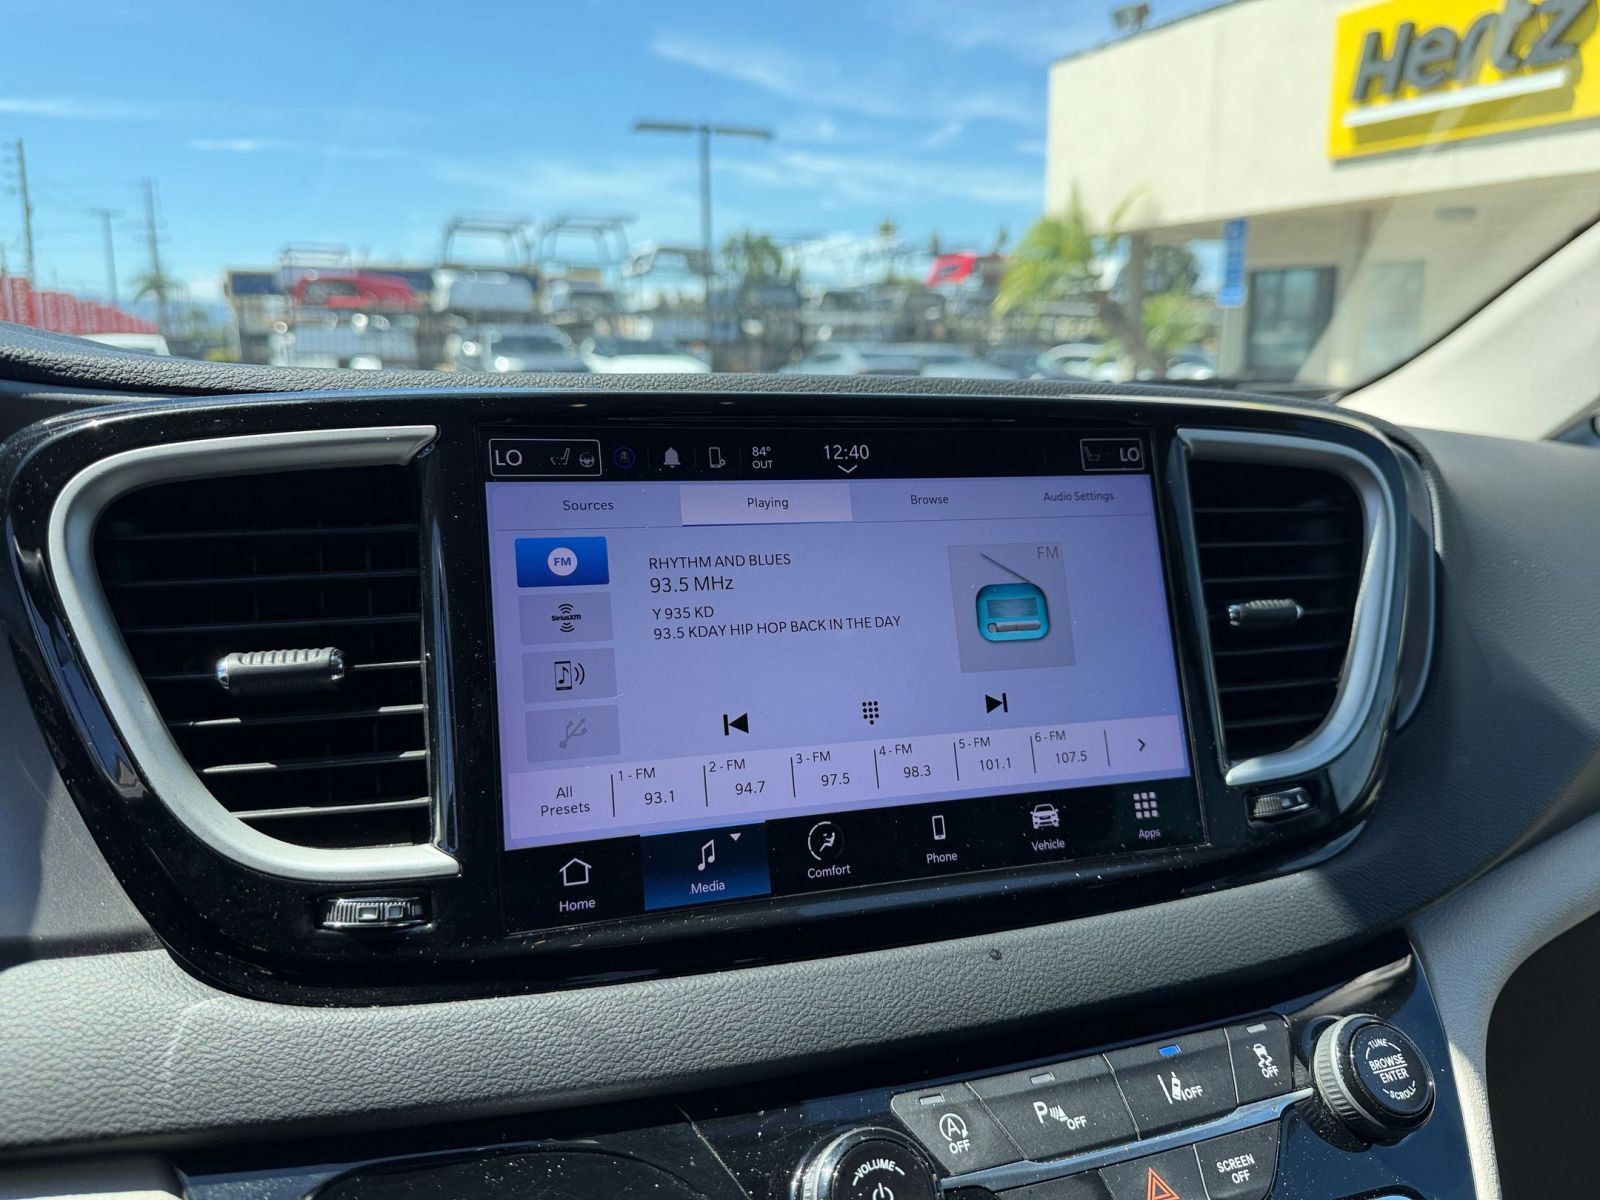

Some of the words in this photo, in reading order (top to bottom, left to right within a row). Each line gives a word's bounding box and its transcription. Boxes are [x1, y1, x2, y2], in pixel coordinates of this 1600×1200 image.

[1352, 0, 1589, 103] Hertz
[495, 449, 523, 466] LO
[752, 447, 771, 457] 84°
[823, 445, 870, 461] 12:40
[1120, 448, 1139, 462] LO
[752, 459, 773, 470] OUT
[747, 497, 789, 510] Playing
[911, 494, 949, 505] Browse
[1044, 491, 1072, 502] Audio
[1074, 491, 1114, 502] Settings
[562, 499, 614, 512] Sources
[1037, 546, 1059, 559] FM
[554, 556, 571, 566] FM
[649, 556, 712, 570] RHYTHM
[715, 555, 745, 567] AND
[749, 554, 791, 566] BLUES
[650, 577, 690, 593] 93.5
[694, 576, 734, 591] MHz
[652, 609, 662, 620] Y
[664, 607, 691, 620] 935
[695, 606, 714, 618] KD
[653, 626, 686, 640] 93.5
[688, 624, 727, 638] KDAY
[730, 623, 754, 636] HIP
[757, 622, 787, 634] HOP
[791, 620, 826, 633] BACK
[829, 619, 843, 631] IN
[846, 618, 872, 630] THE
[874, 616, 901, 628] DAY
[959, 739, 965, 749] 5
[974, 737, 990, 748] FM
[1035, 733, 1041, 742] 6
[1049, 730, 1066, 741] FM
[879, 745, 887, 755] 4
[895, 744, 912, 754] FM
[796, 754, 803, 764] 3
[813, 751, 831, 763] FM
[979, 757, 1012, 771] 101.1
[1055, 750, 1087, 764] 107.5
[709, 762, 716, 772] 2
[727, 759, 746, 771] FM
[903, 765, 931, 779] 98.3
[618, 771, 624, 781] 1
[636, 767, 656, 780] FM
[821, 772, 850, 787] 97.5
[556, 786, 573, 798] All
[735, 781, 765, 796] 94.7
[644, 790, 675, 805] 93.1
[540, 802, 590, 817] Presets
[1139, 828, 1161, 840] Apps
[1031, 839, 1065, 851] Vehicle
[926, 851, 957, 864] Phone
[807, 864, 851, 879] Comfort
[691, 880, 725, 894] Media
[559, 898, 596, 912] Home
[1368, 1038, 1388, 1048] TUNE
[1369, 1054, 1406, 1071] BROWSE
[1262, 1066, 1279, 1079] OFF
[1380, 1068, 1409, 1083] ENTER
[1185, 1086, 1204, 1099] OFF
[1389, 1085, 1417, 1100] SCROLL
[1033, 1102, 1048, 1124] P
[1067, 1115, 1087, 1130] OFF
[949, 1139, 970, 1154] OFF
[855, 1159, 896, 1179] VOLUME
[1216, 1154, 1255, 1173] SCREEN
[1232, 1169, 1250, 1184] OFF
